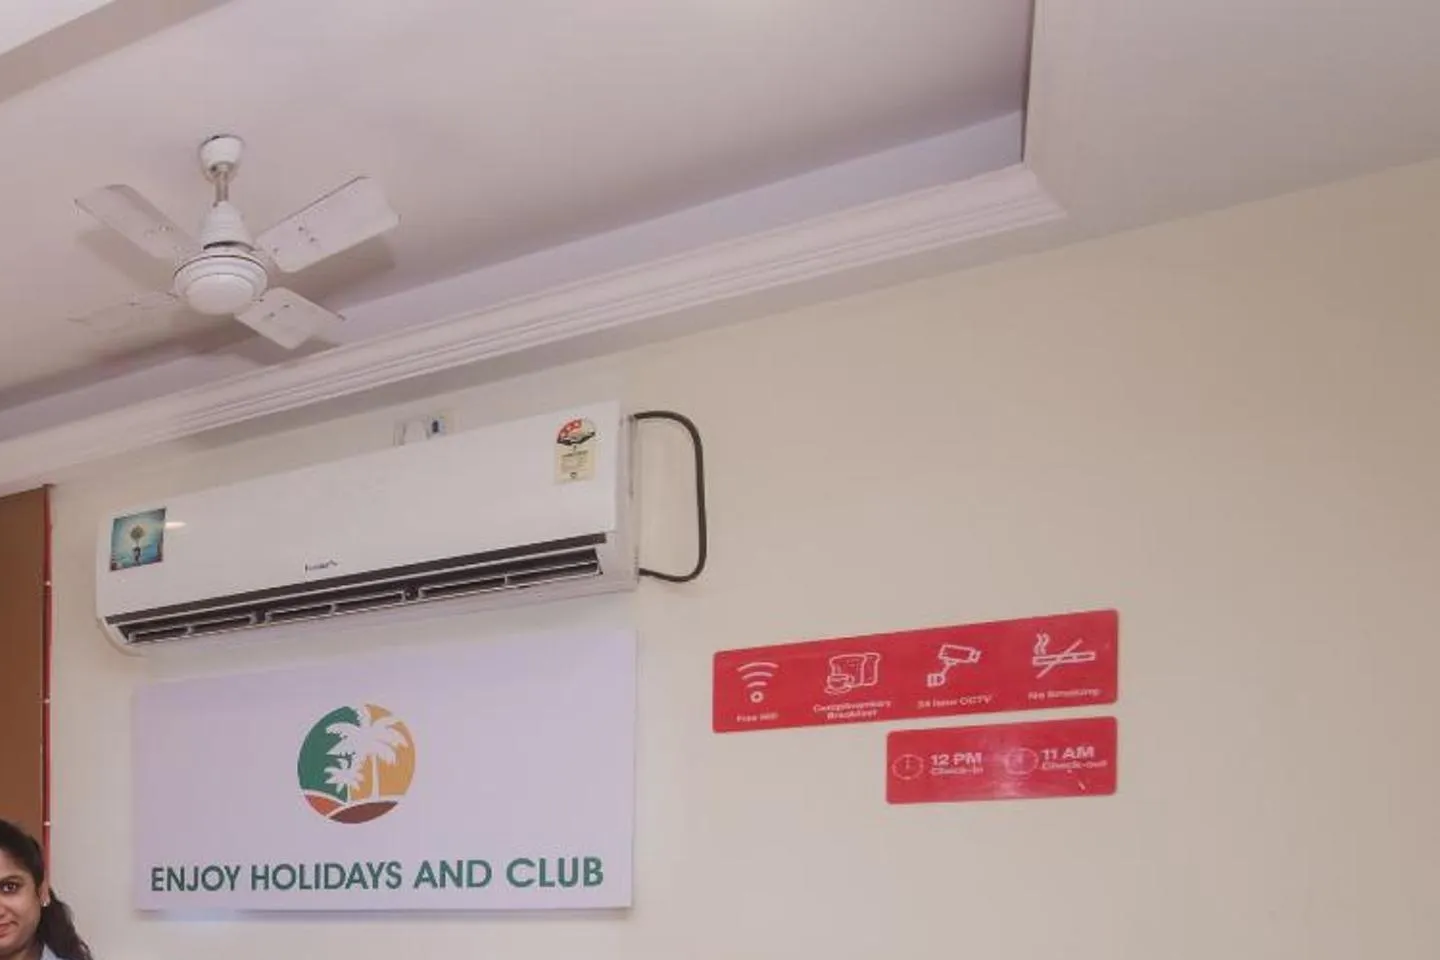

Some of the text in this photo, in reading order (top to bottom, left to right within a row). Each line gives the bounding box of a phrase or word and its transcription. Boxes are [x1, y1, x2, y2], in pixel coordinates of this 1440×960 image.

[930, 751, 983, 766] 12 PM
[1041, 745, 1094, 760] 11 AM
[151, 856, 604, 892] ENJOY HOLIDAYS AND CLUB
